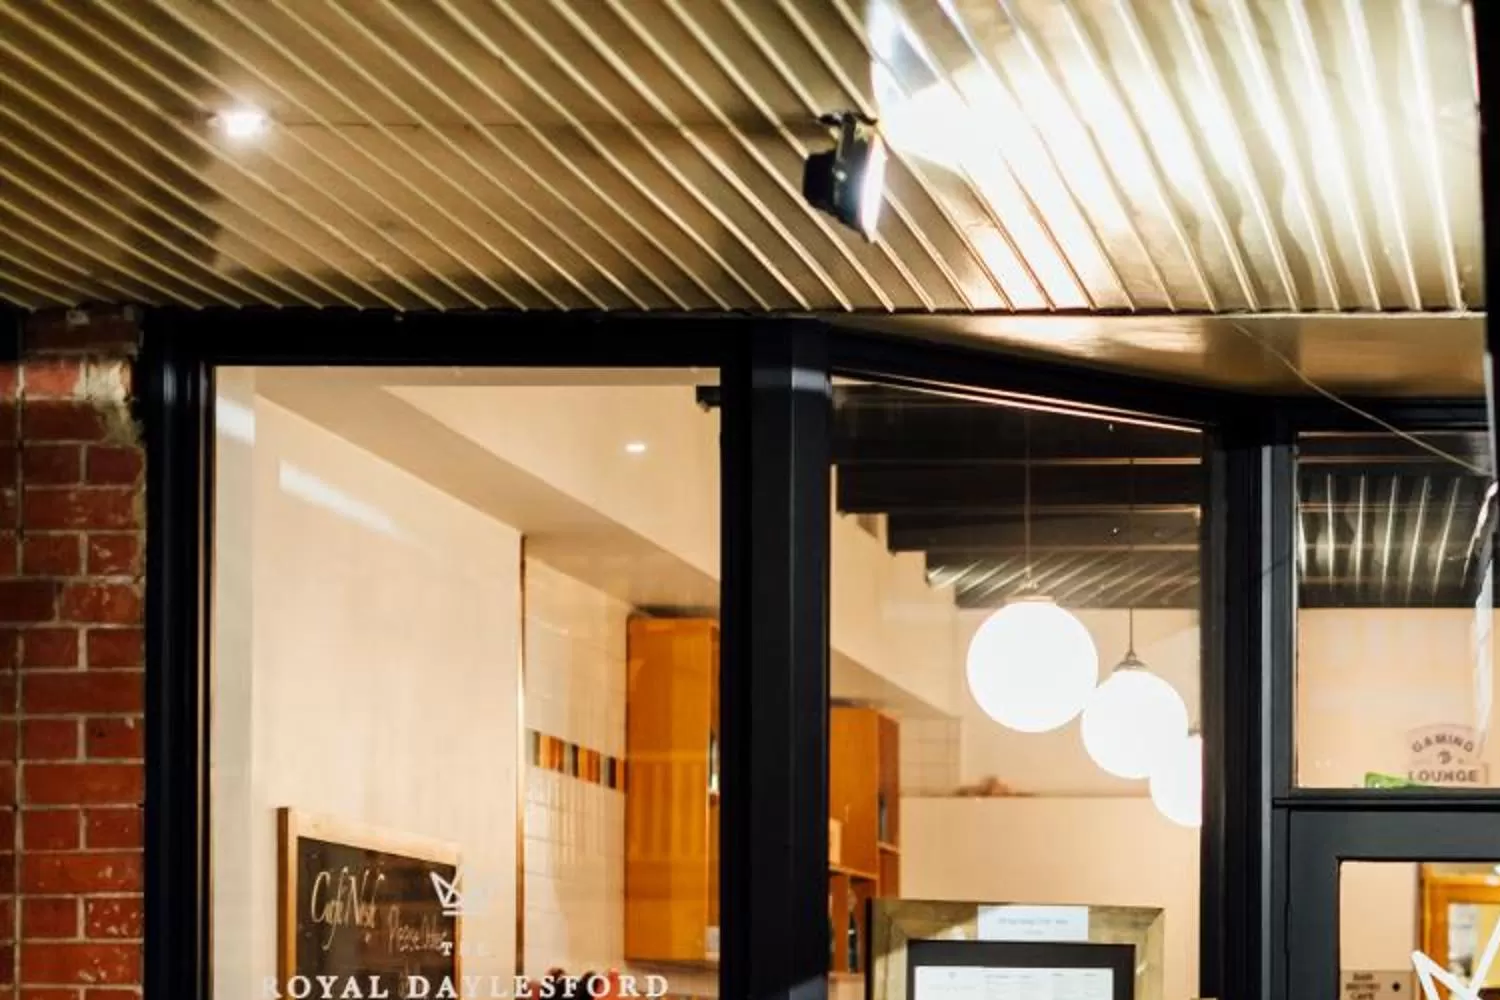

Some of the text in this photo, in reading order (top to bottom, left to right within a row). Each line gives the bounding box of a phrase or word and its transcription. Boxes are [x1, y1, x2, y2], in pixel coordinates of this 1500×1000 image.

[1411, 733, 1476, 753] GAMING
[1409, 768, 1480, 783] LOUNGE
[262, 974, 670, 1000] ROYAL DAYLESFORD
